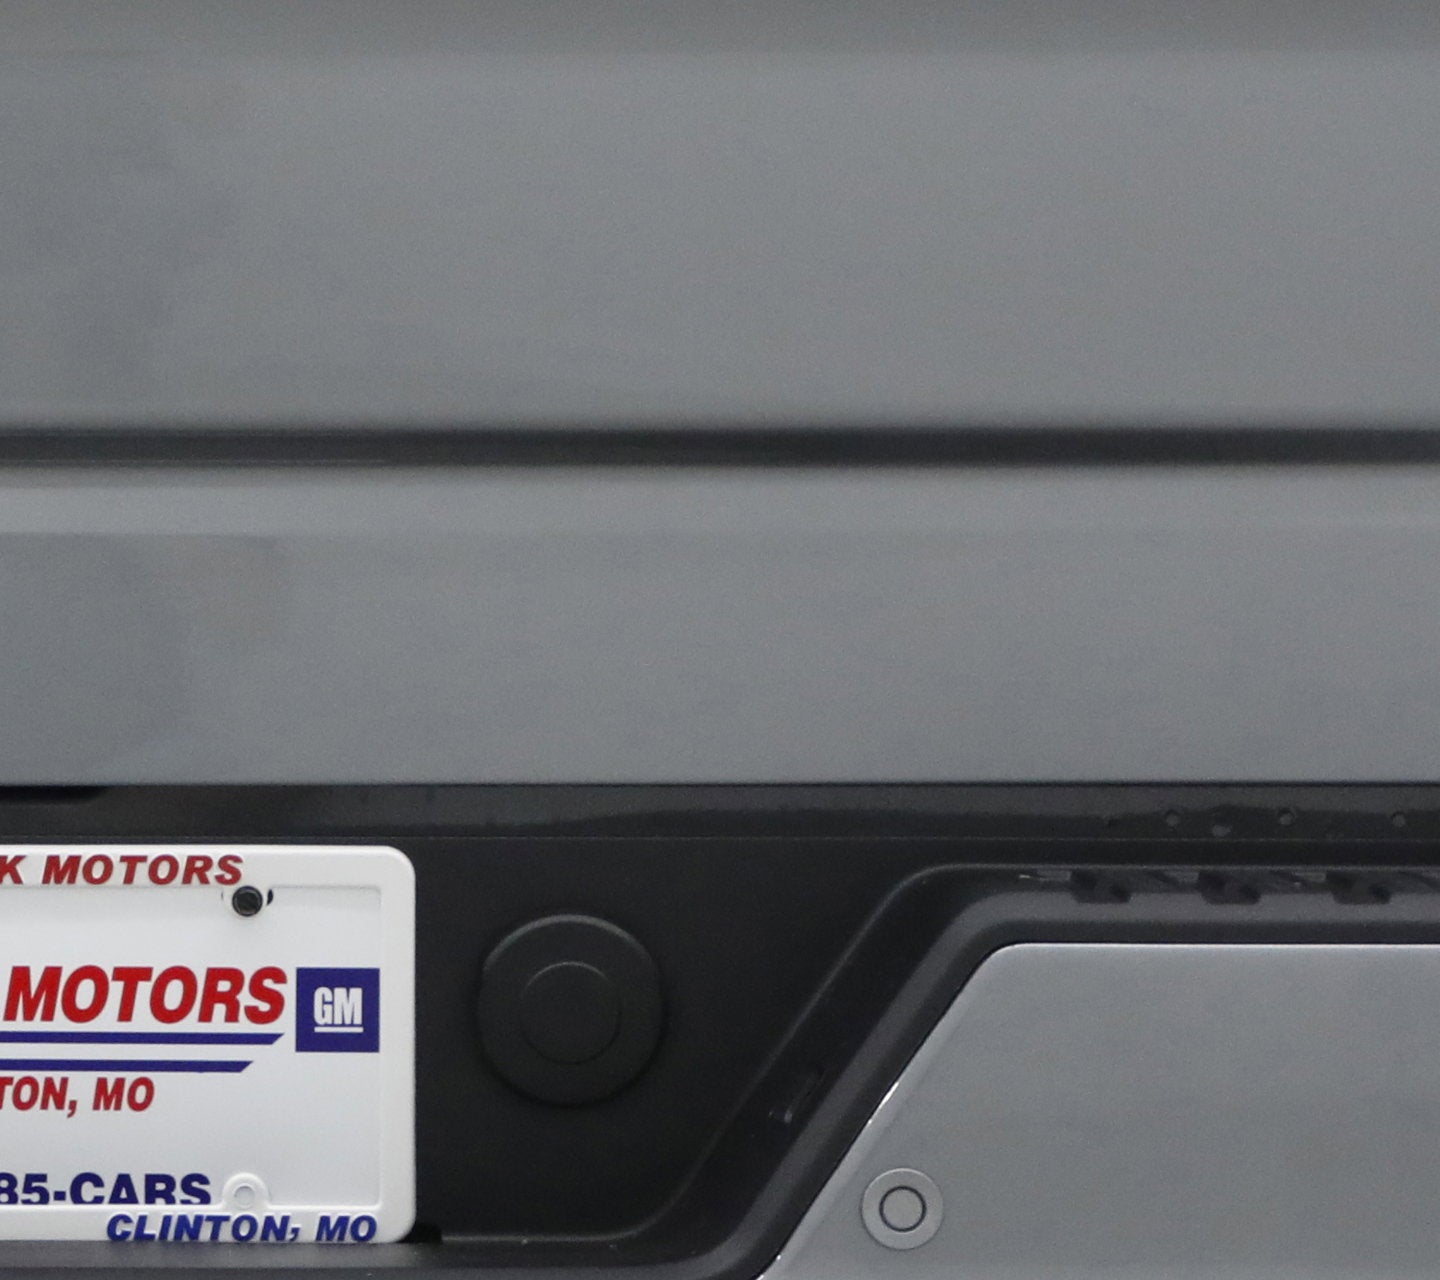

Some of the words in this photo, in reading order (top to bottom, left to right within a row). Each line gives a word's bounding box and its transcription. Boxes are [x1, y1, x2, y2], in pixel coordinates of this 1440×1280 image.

[41, 854, 245, 885] MOTORS
[3, 964, 289, 1024] MOTORS
[312, 987, 364, 1026] GM
[92, 1077, 155, 1113] MO
[105, 1215, 302, 1244] CLINTON,
[316, 1216, 378, 1243] MO
